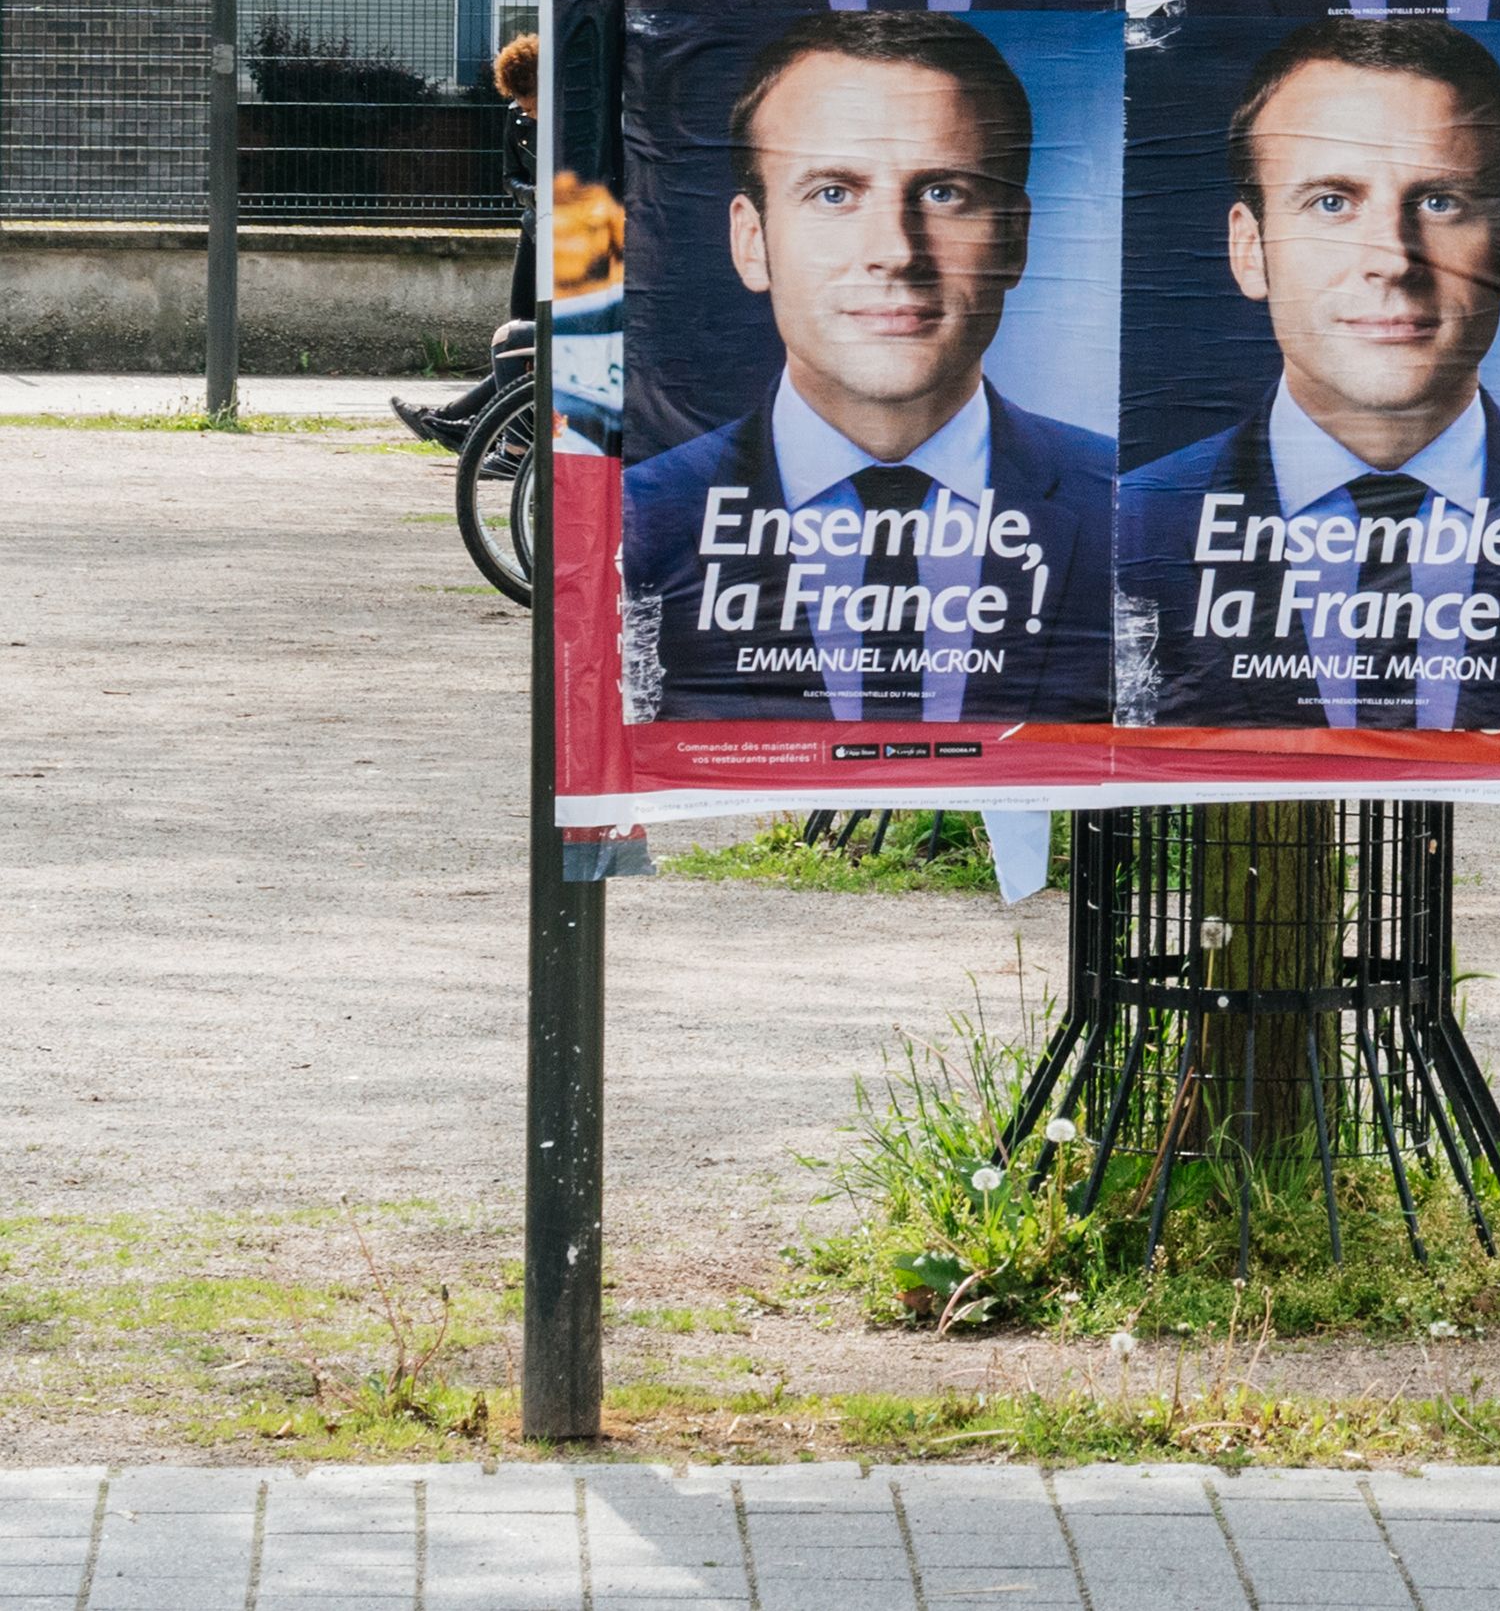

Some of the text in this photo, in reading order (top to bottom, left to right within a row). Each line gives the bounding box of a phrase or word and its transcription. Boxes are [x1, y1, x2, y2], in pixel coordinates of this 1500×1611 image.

[699, 487, 1043, 571] Ensemble,
[698, 563, 760, 630] la
[780, 563, 1008, 633] France
[1193, 569, 1255, 638] la
[1275, 570, 1500, 641] France
[736, 648, 1004, 673] EMMANUEL MACRON
[1232, 654, 1497, 681] EMMANUEL MACRON
[677, 742, 817, 752] Commandez dès maintenant
[692, 756, 709, 764] vos
[711, 755, 767, 764] restaurants
